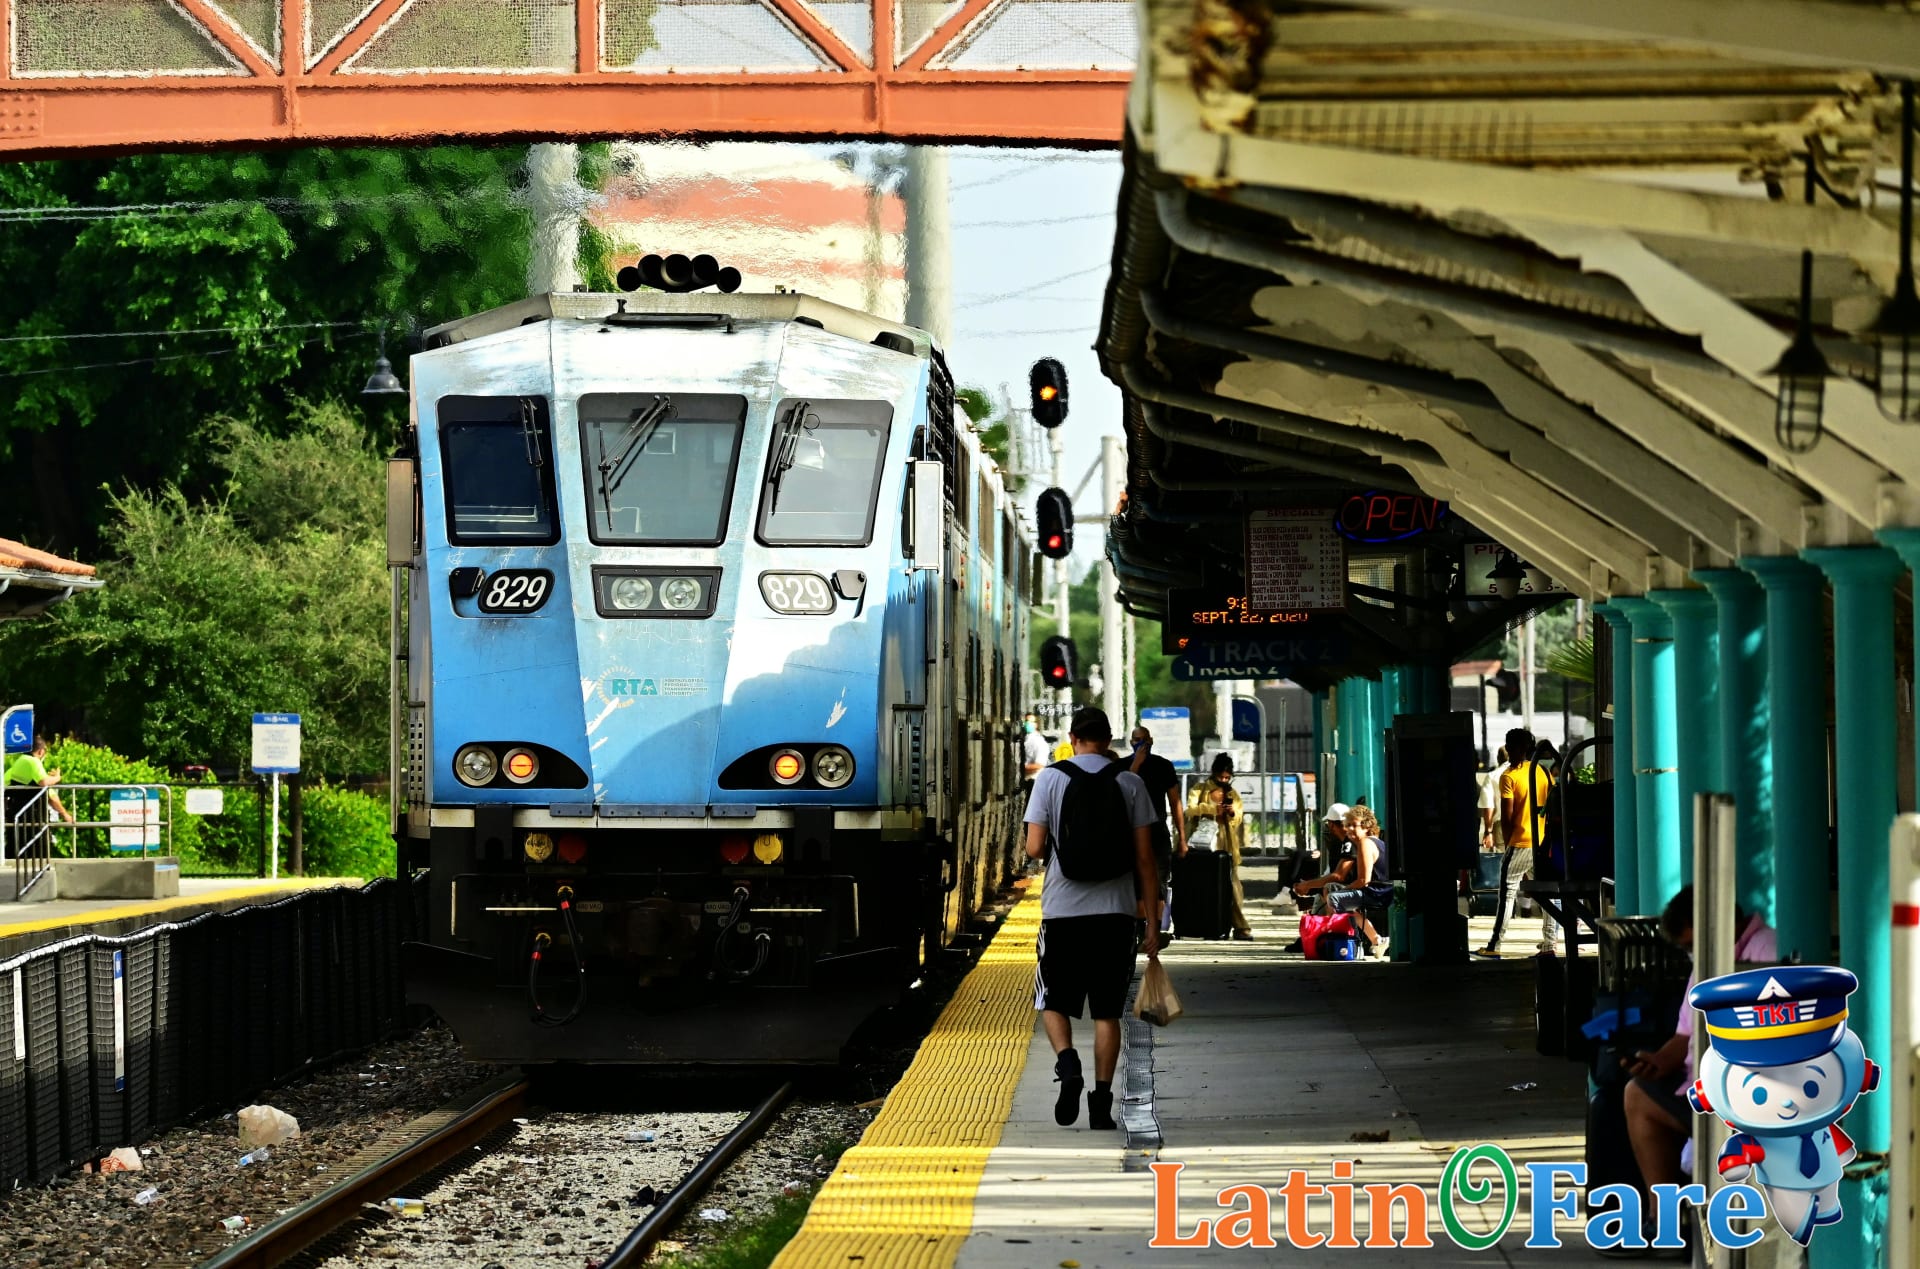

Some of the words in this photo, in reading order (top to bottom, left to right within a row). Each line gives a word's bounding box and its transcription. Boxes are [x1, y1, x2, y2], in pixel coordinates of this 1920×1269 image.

[1341, 496, 1438, 531] OPEN
[486, 576, 547, 607] 829
[767, 577, 828, 608] 829
[1193, 611, 1234, 624] SEPT.
[1239, 611, 1264, 624] 22,
[1269, 612, 1308, 623] 2020
[1202, 640, 1307, 663] TRACK
[612, 678, 658, 696] RTA
